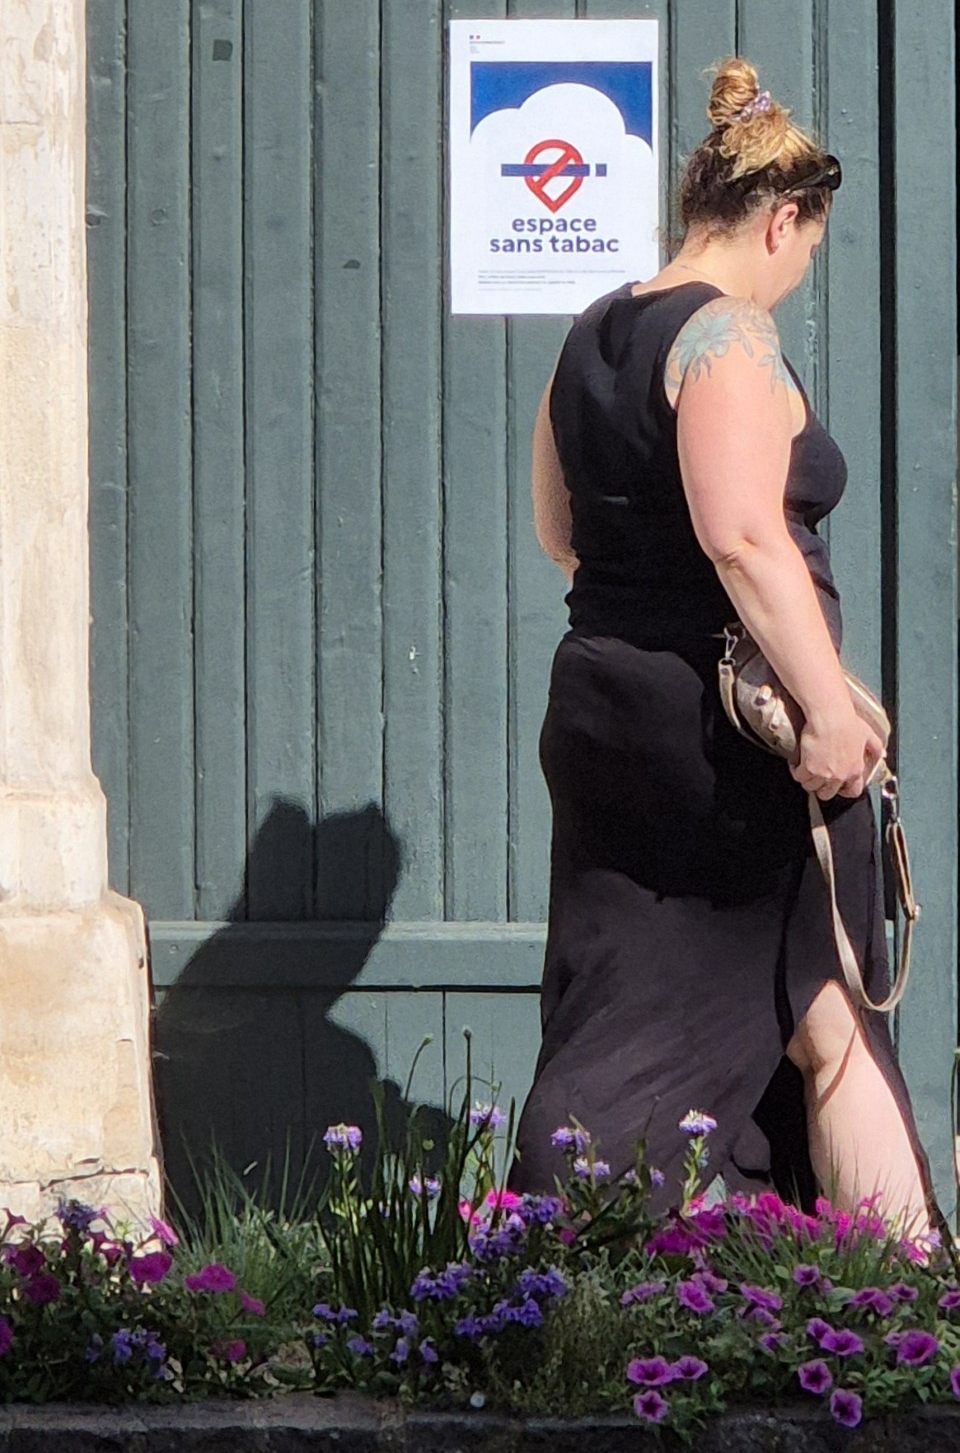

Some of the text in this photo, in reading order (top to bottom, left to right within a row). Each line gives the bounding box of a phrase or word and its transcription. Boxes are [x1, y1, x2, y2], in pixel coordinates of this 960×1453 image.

[511, 217, 597, 236] espace
[489, 235, 619, 253] sans tabac
